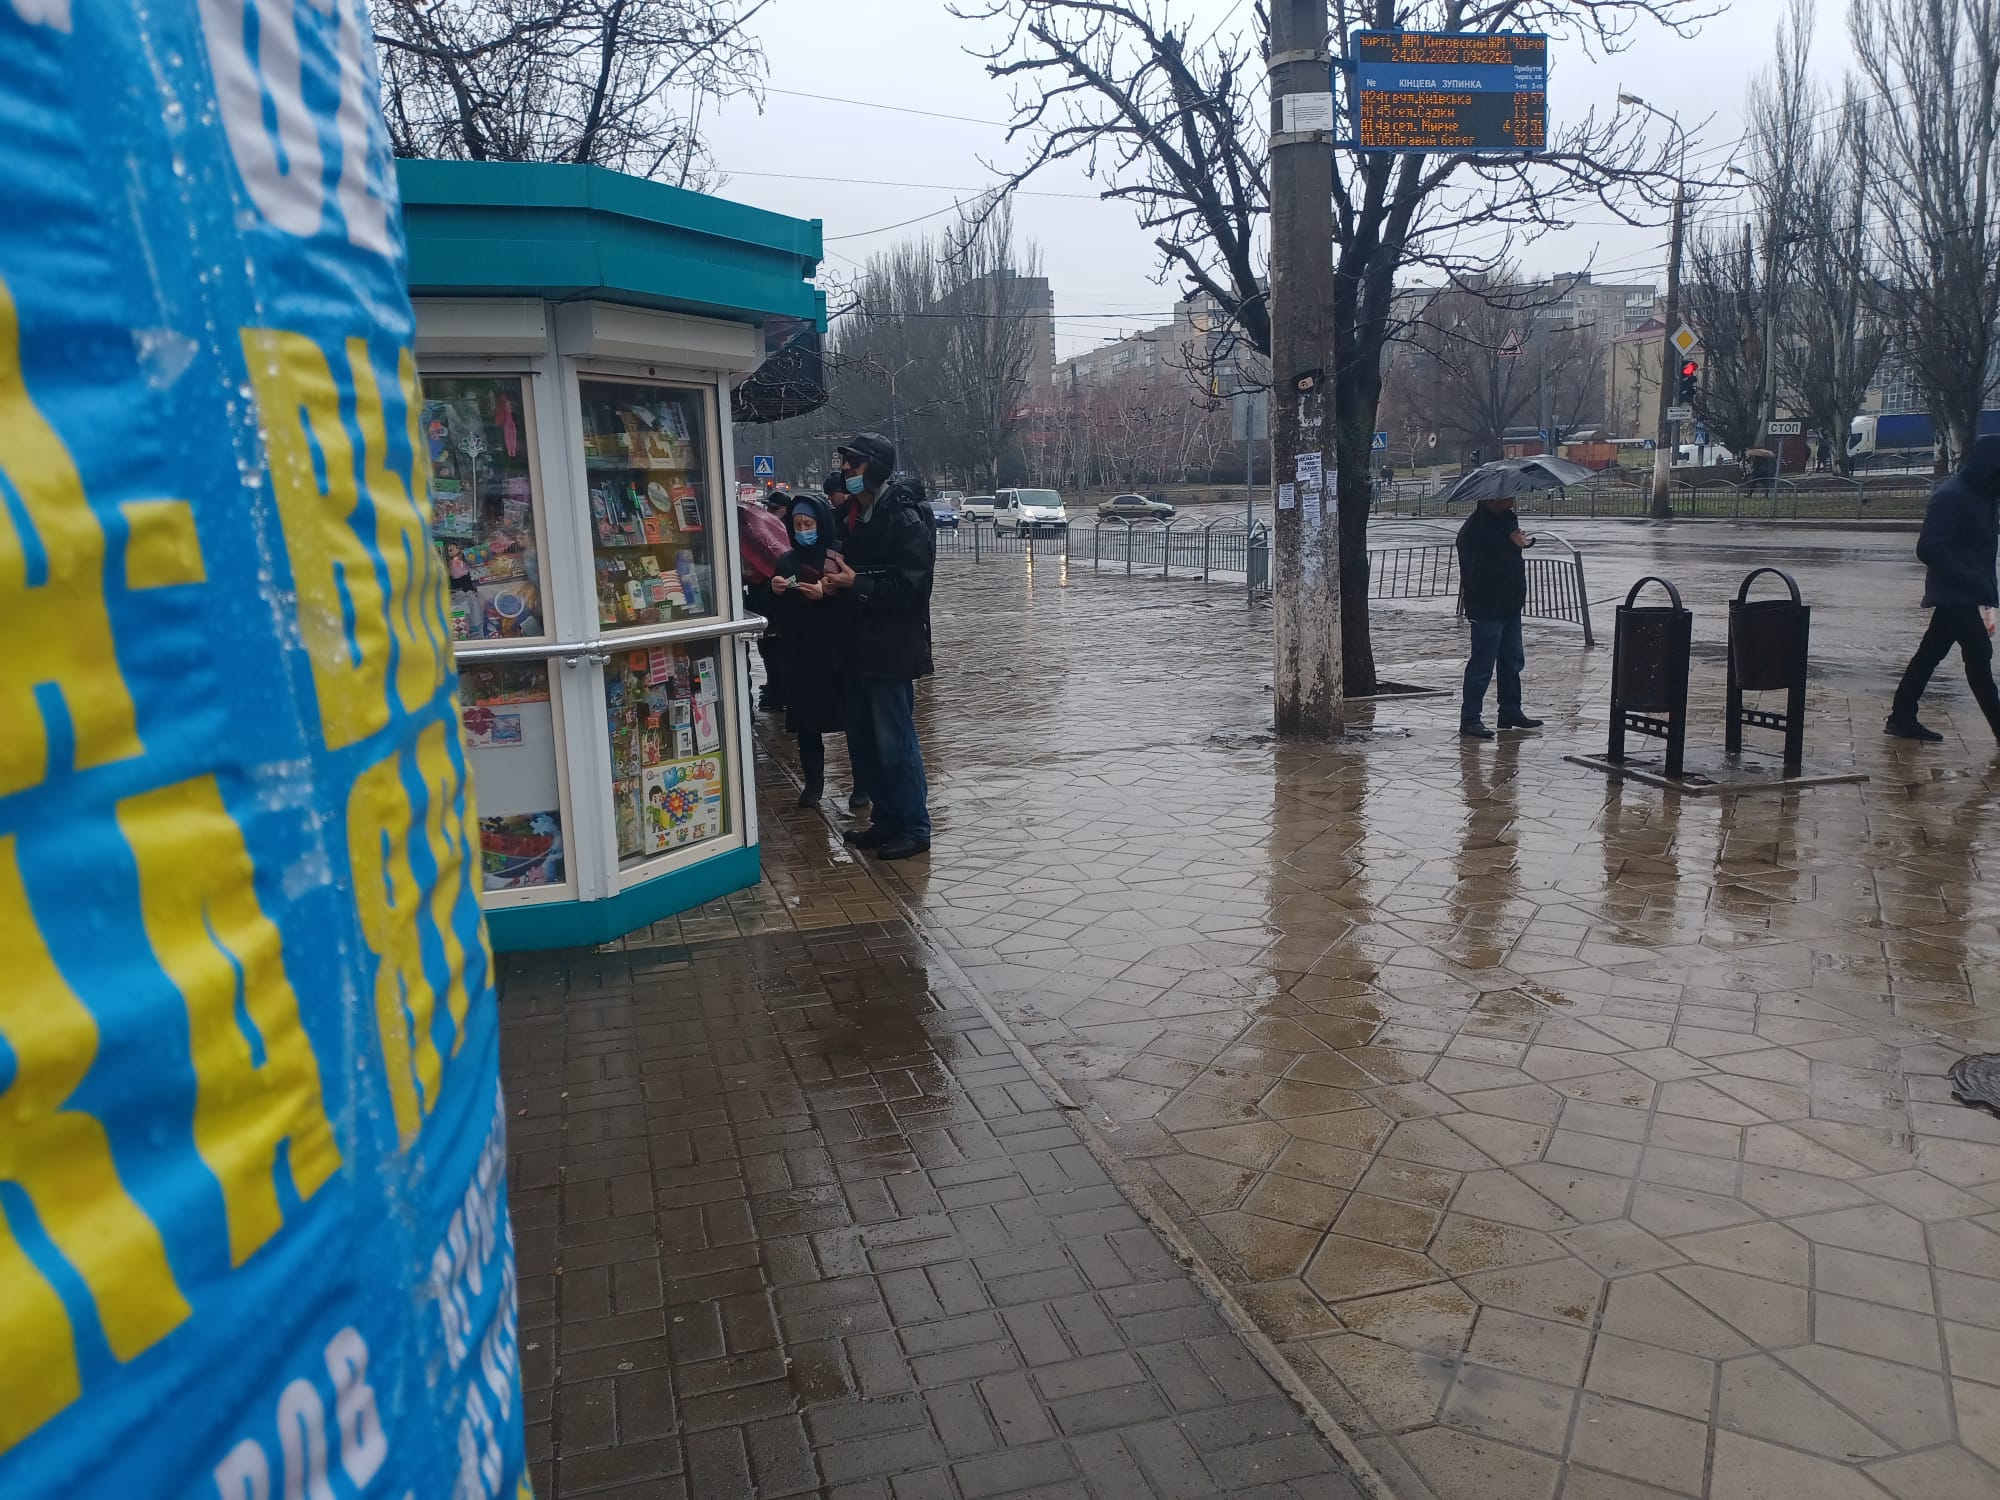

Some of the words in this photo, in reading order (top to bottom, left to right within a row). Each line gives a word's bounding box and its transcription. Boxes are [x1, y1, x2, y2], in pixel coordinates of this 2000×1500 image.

[1391, 48, 1459, 63] 24.02.2022
[1462, 50, 1513, 64] 09:22:21
[1514, 65, 1543, 73] Прибуття
[1366, 78, 1377, 87] №
[1399, 78, 1437, 89] КІНЦЕВА
[1442, 79, 1482, 89] ЗУПИНКА
[1392, 120, 1418, 132] сел.
[1421, 119, 1460, 132] Мирне
[1514, 120, 1529, 133] 27
[1531, 120, 1545, 133] 51
[1440, 133, 1475, 146] берег
[1514, 133, 1529, 146] 32
[1771, 423, 1799, 433] СТОП
